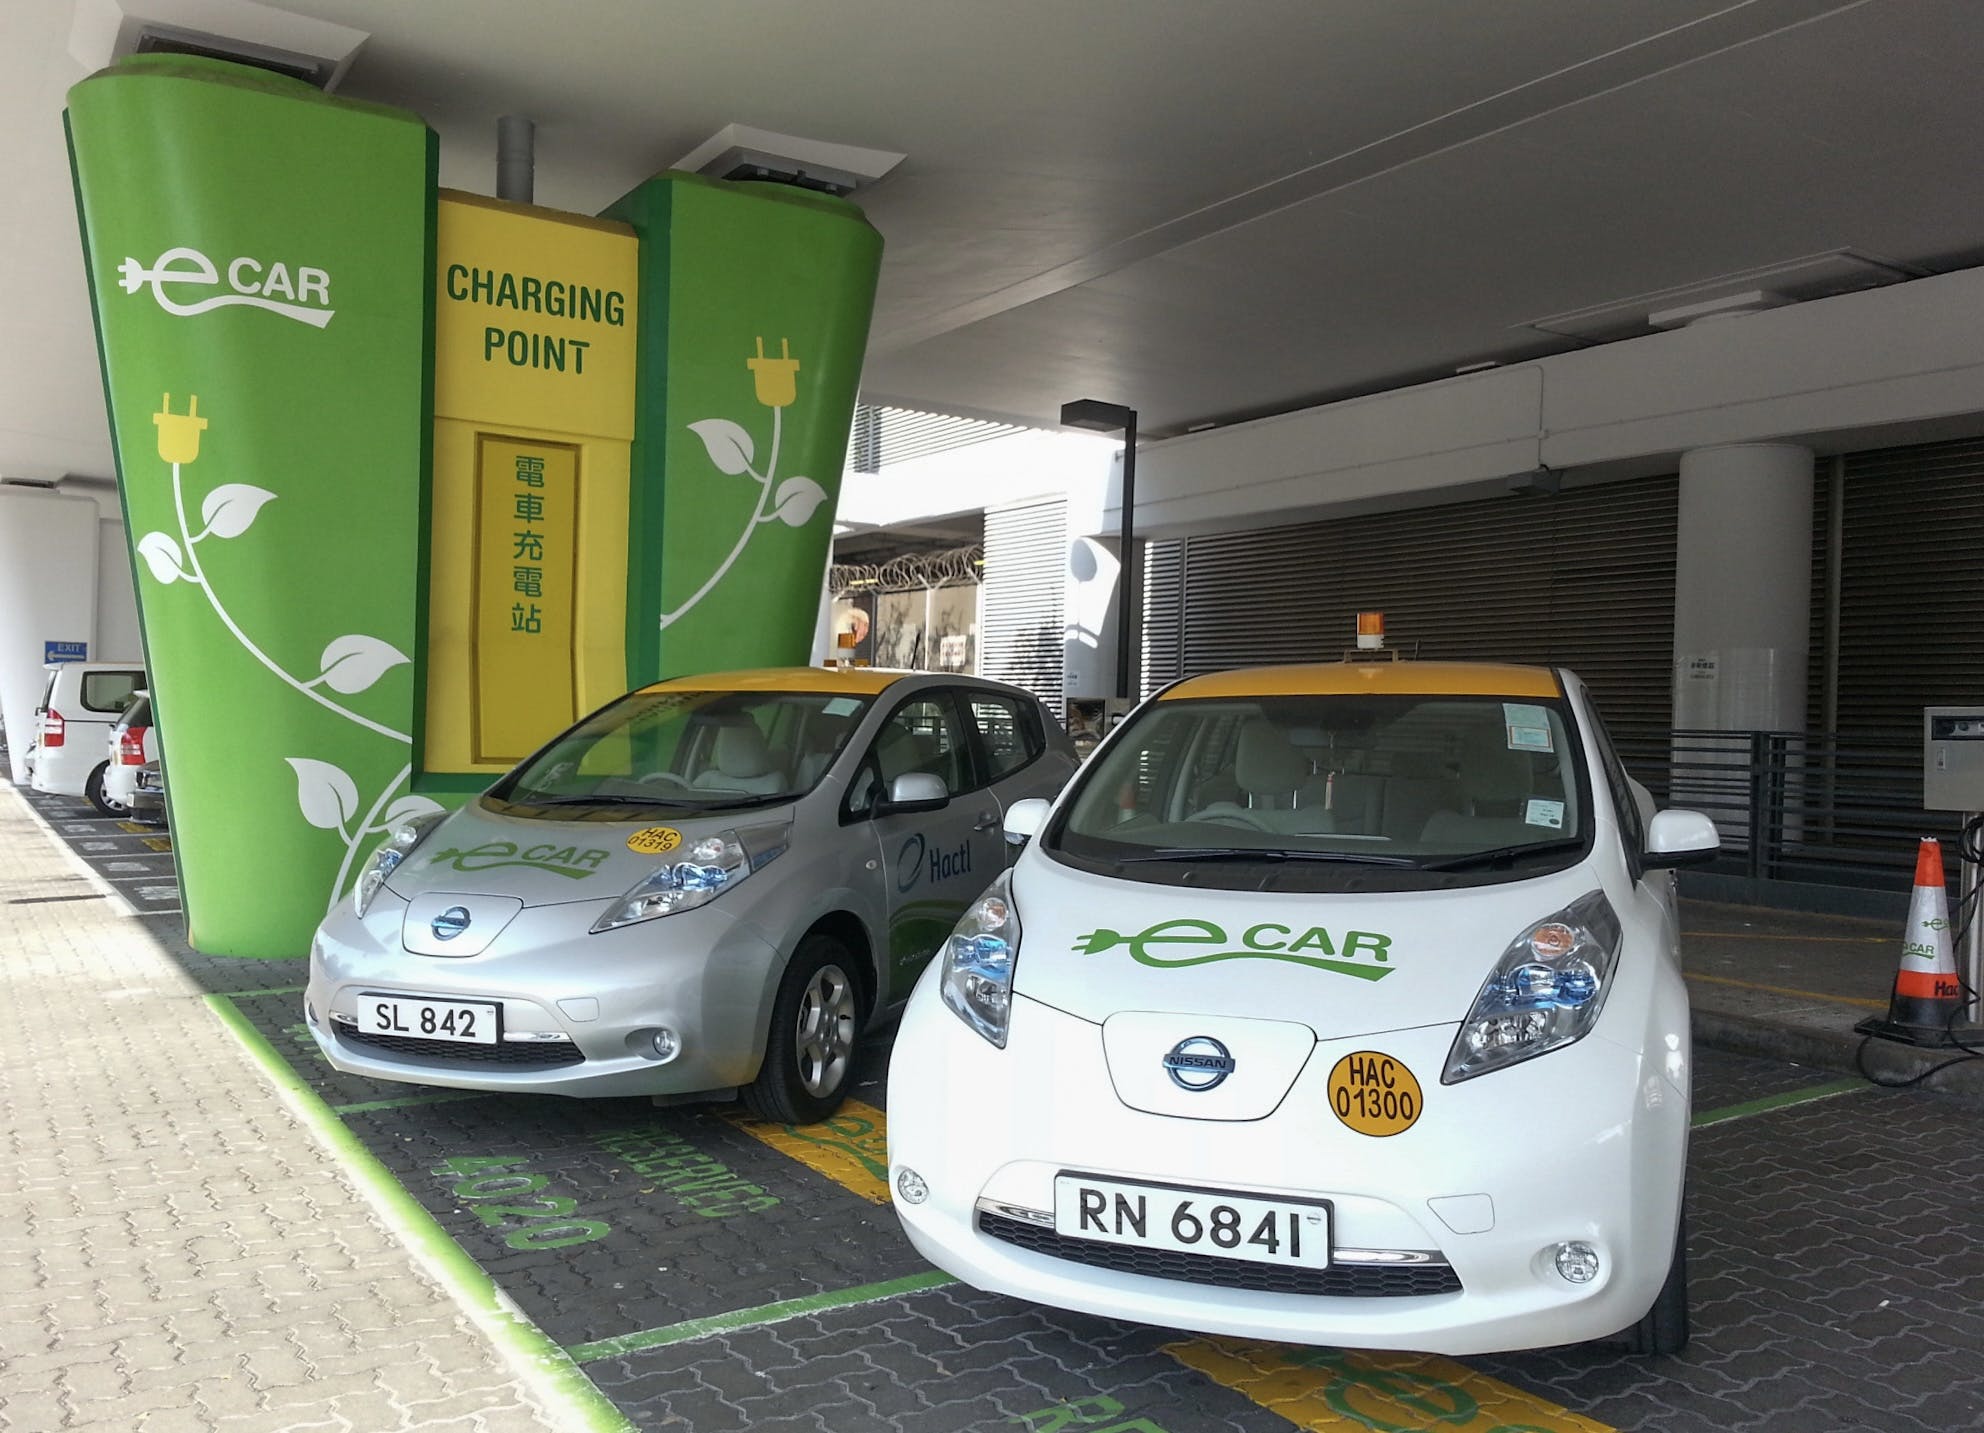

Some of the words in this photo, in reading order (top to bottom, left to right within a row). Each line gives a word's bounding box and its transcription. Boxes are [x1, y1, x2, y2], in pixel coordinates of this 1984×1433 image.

[228, 256, 330, 305] CAR
[447, 264, 625, 327] CHARGING
[484, 327, 590, 375] POINT
[511, 455, 545, 634] 電車充電站
[57, 643, 81, 653] EXIT
[628, 836, 672, 851] 01319
[641, 828, 678, 841] HAC
[521, 844, 611, 868] CAR
[929, 839, 971, 883] Hactl
[1242, 923, 1393, 962] CAR
[1909, 943, 1935, 954] CAR
[376, 1003, 410, 1032] SL
[420, 1007, 476, 1038] 842
[1169, 1056, 1227, 1069] NISSAN
[1349, 1055, 1395, 1089] HAC
[1336, 1086, 1414, 1120] 01300
[590, 1126, 783, 1217] RESERVED
[431, 1156, 612, 1250] 4020
[1079, 1187, 1149, 1238] RN
[1171, 1200, 1301, 1258] 6841
